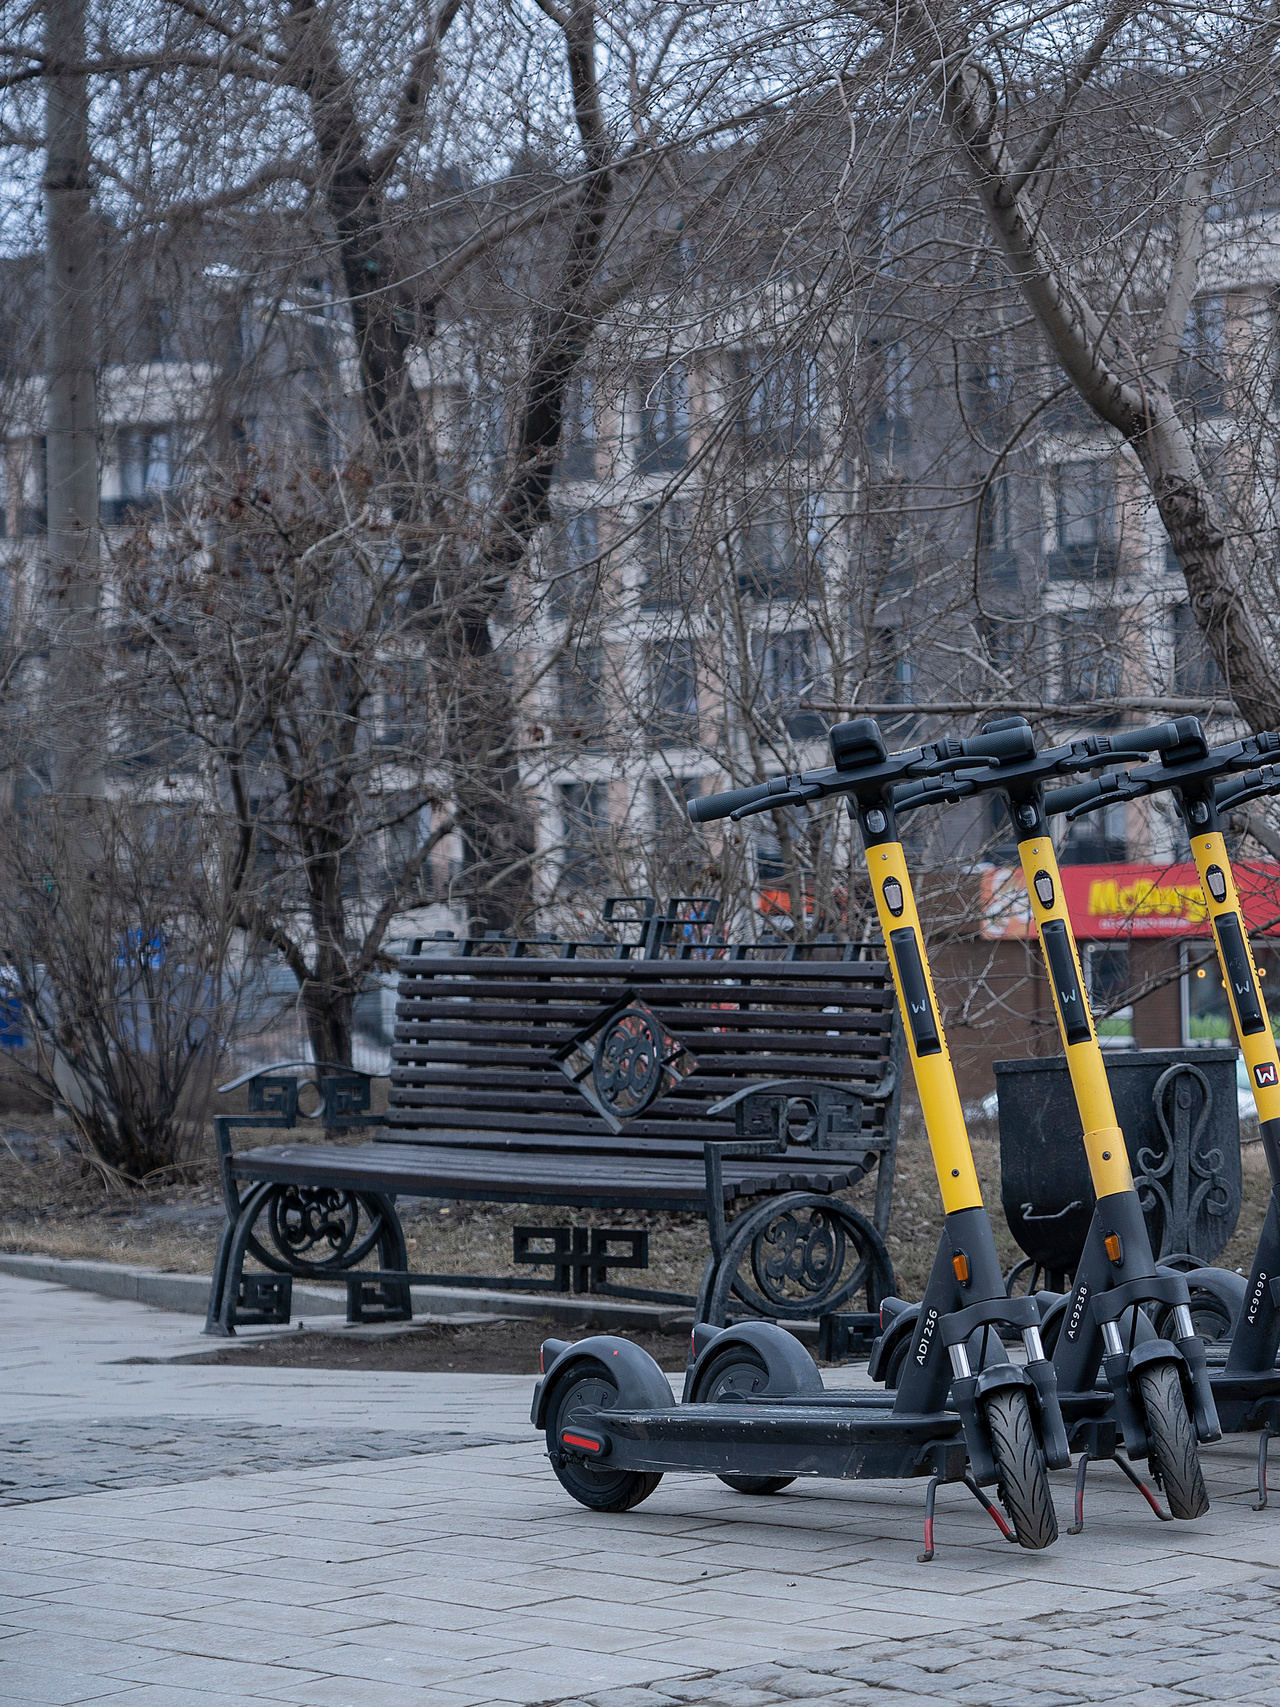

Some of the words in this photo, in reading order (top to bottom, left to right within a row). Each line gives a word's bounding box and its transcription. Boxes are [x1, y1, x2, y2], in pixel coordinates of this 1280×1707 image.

[1066, 1286, 1088, 1339] AC9238
[1247, 1272, 1267, 1324] AC9090
[916, 1308, 938, 1366] AD1236
